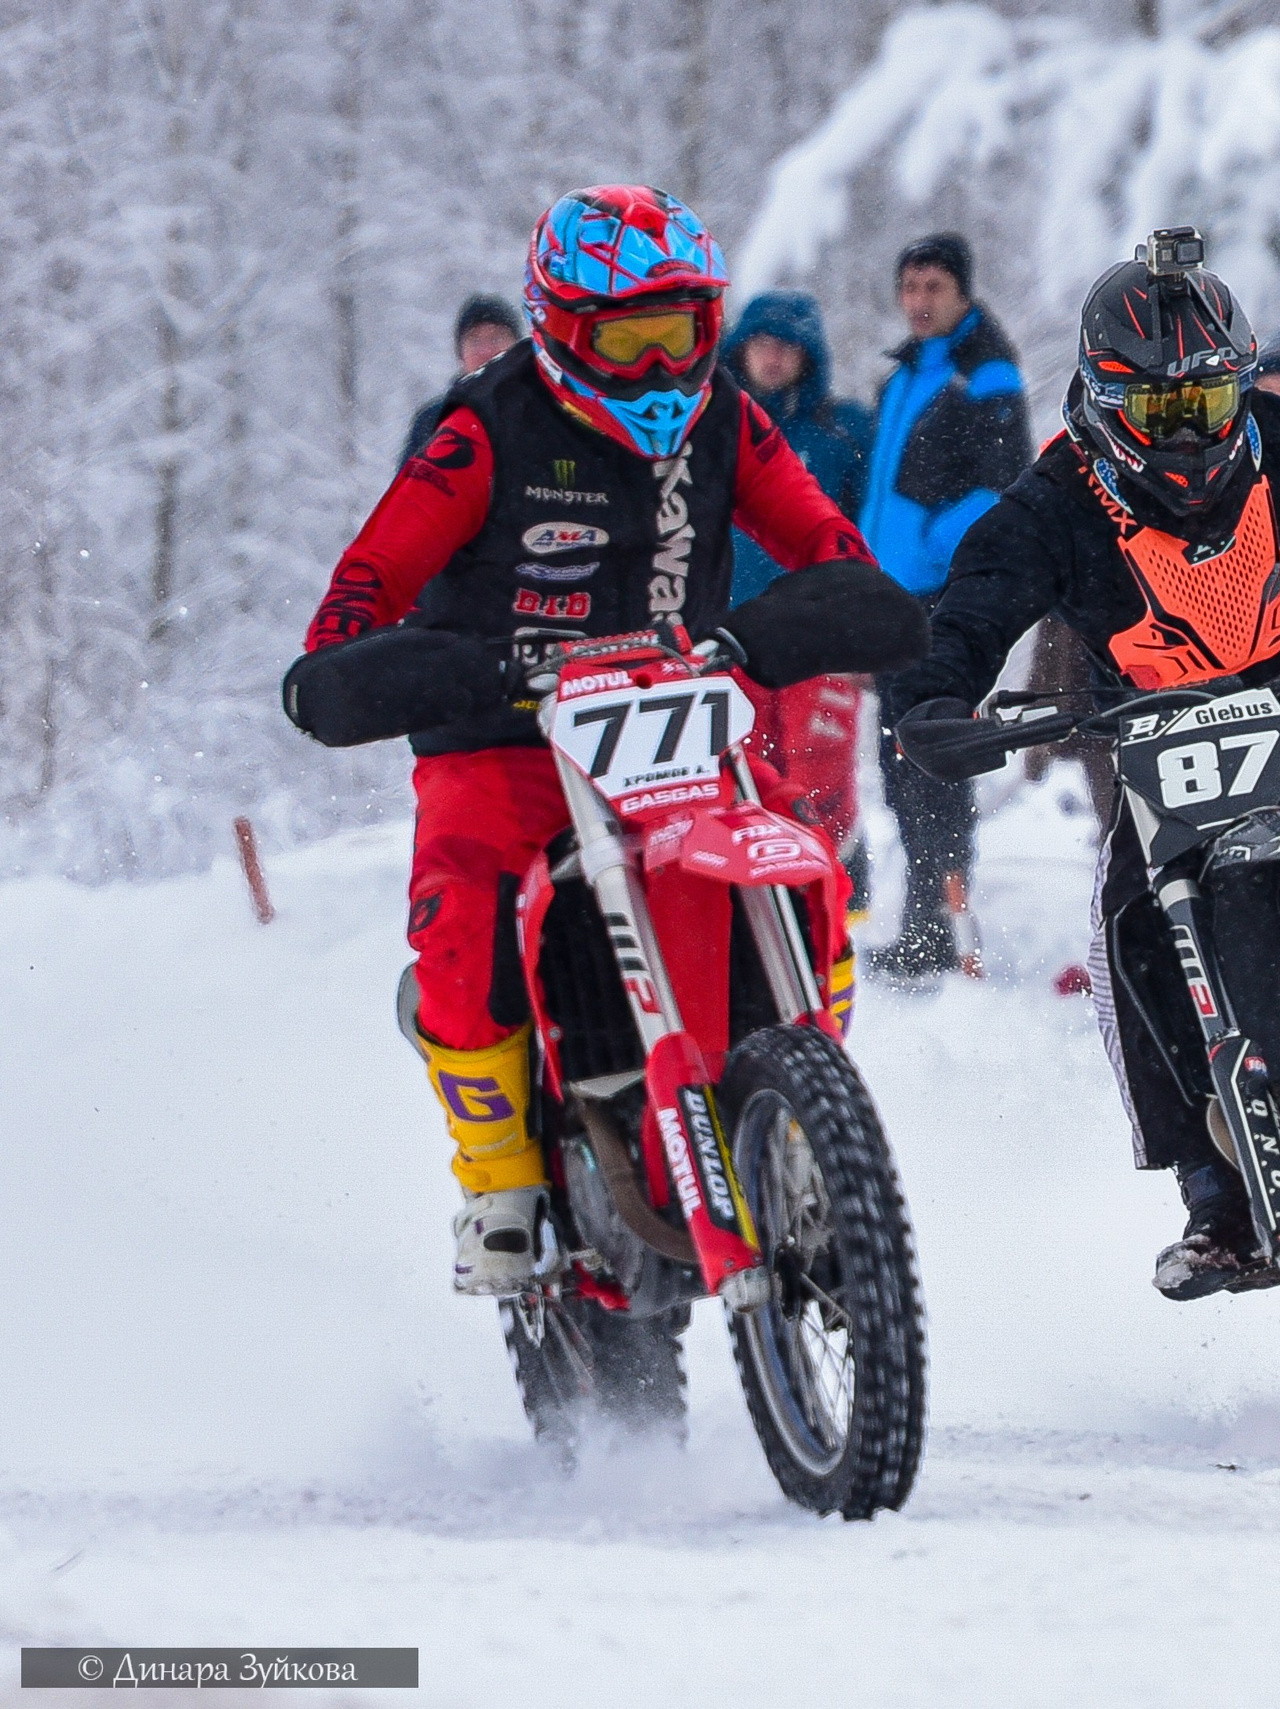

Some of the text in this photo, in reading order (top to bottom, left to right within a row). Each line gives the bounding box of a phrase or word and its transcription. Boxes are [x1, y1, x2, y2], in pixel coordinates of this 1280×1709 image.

[1167, 347, 1238, 377] UFO
[525, 485, 609, 505] MONSTER
[535, 529, 597, 542] AMA
[561, 670, 633, 696] MOTUL
[1195, 700, 1273, 726] Glebus
[572, 688, 731, 779] 771
[1157, 730, 1280, 809] 87
[620, 783, 719, 815] GASGAS
[657, 1107, 701, 1220] MOTUL
[684, 1090, 736, 1219] DUNLOP
